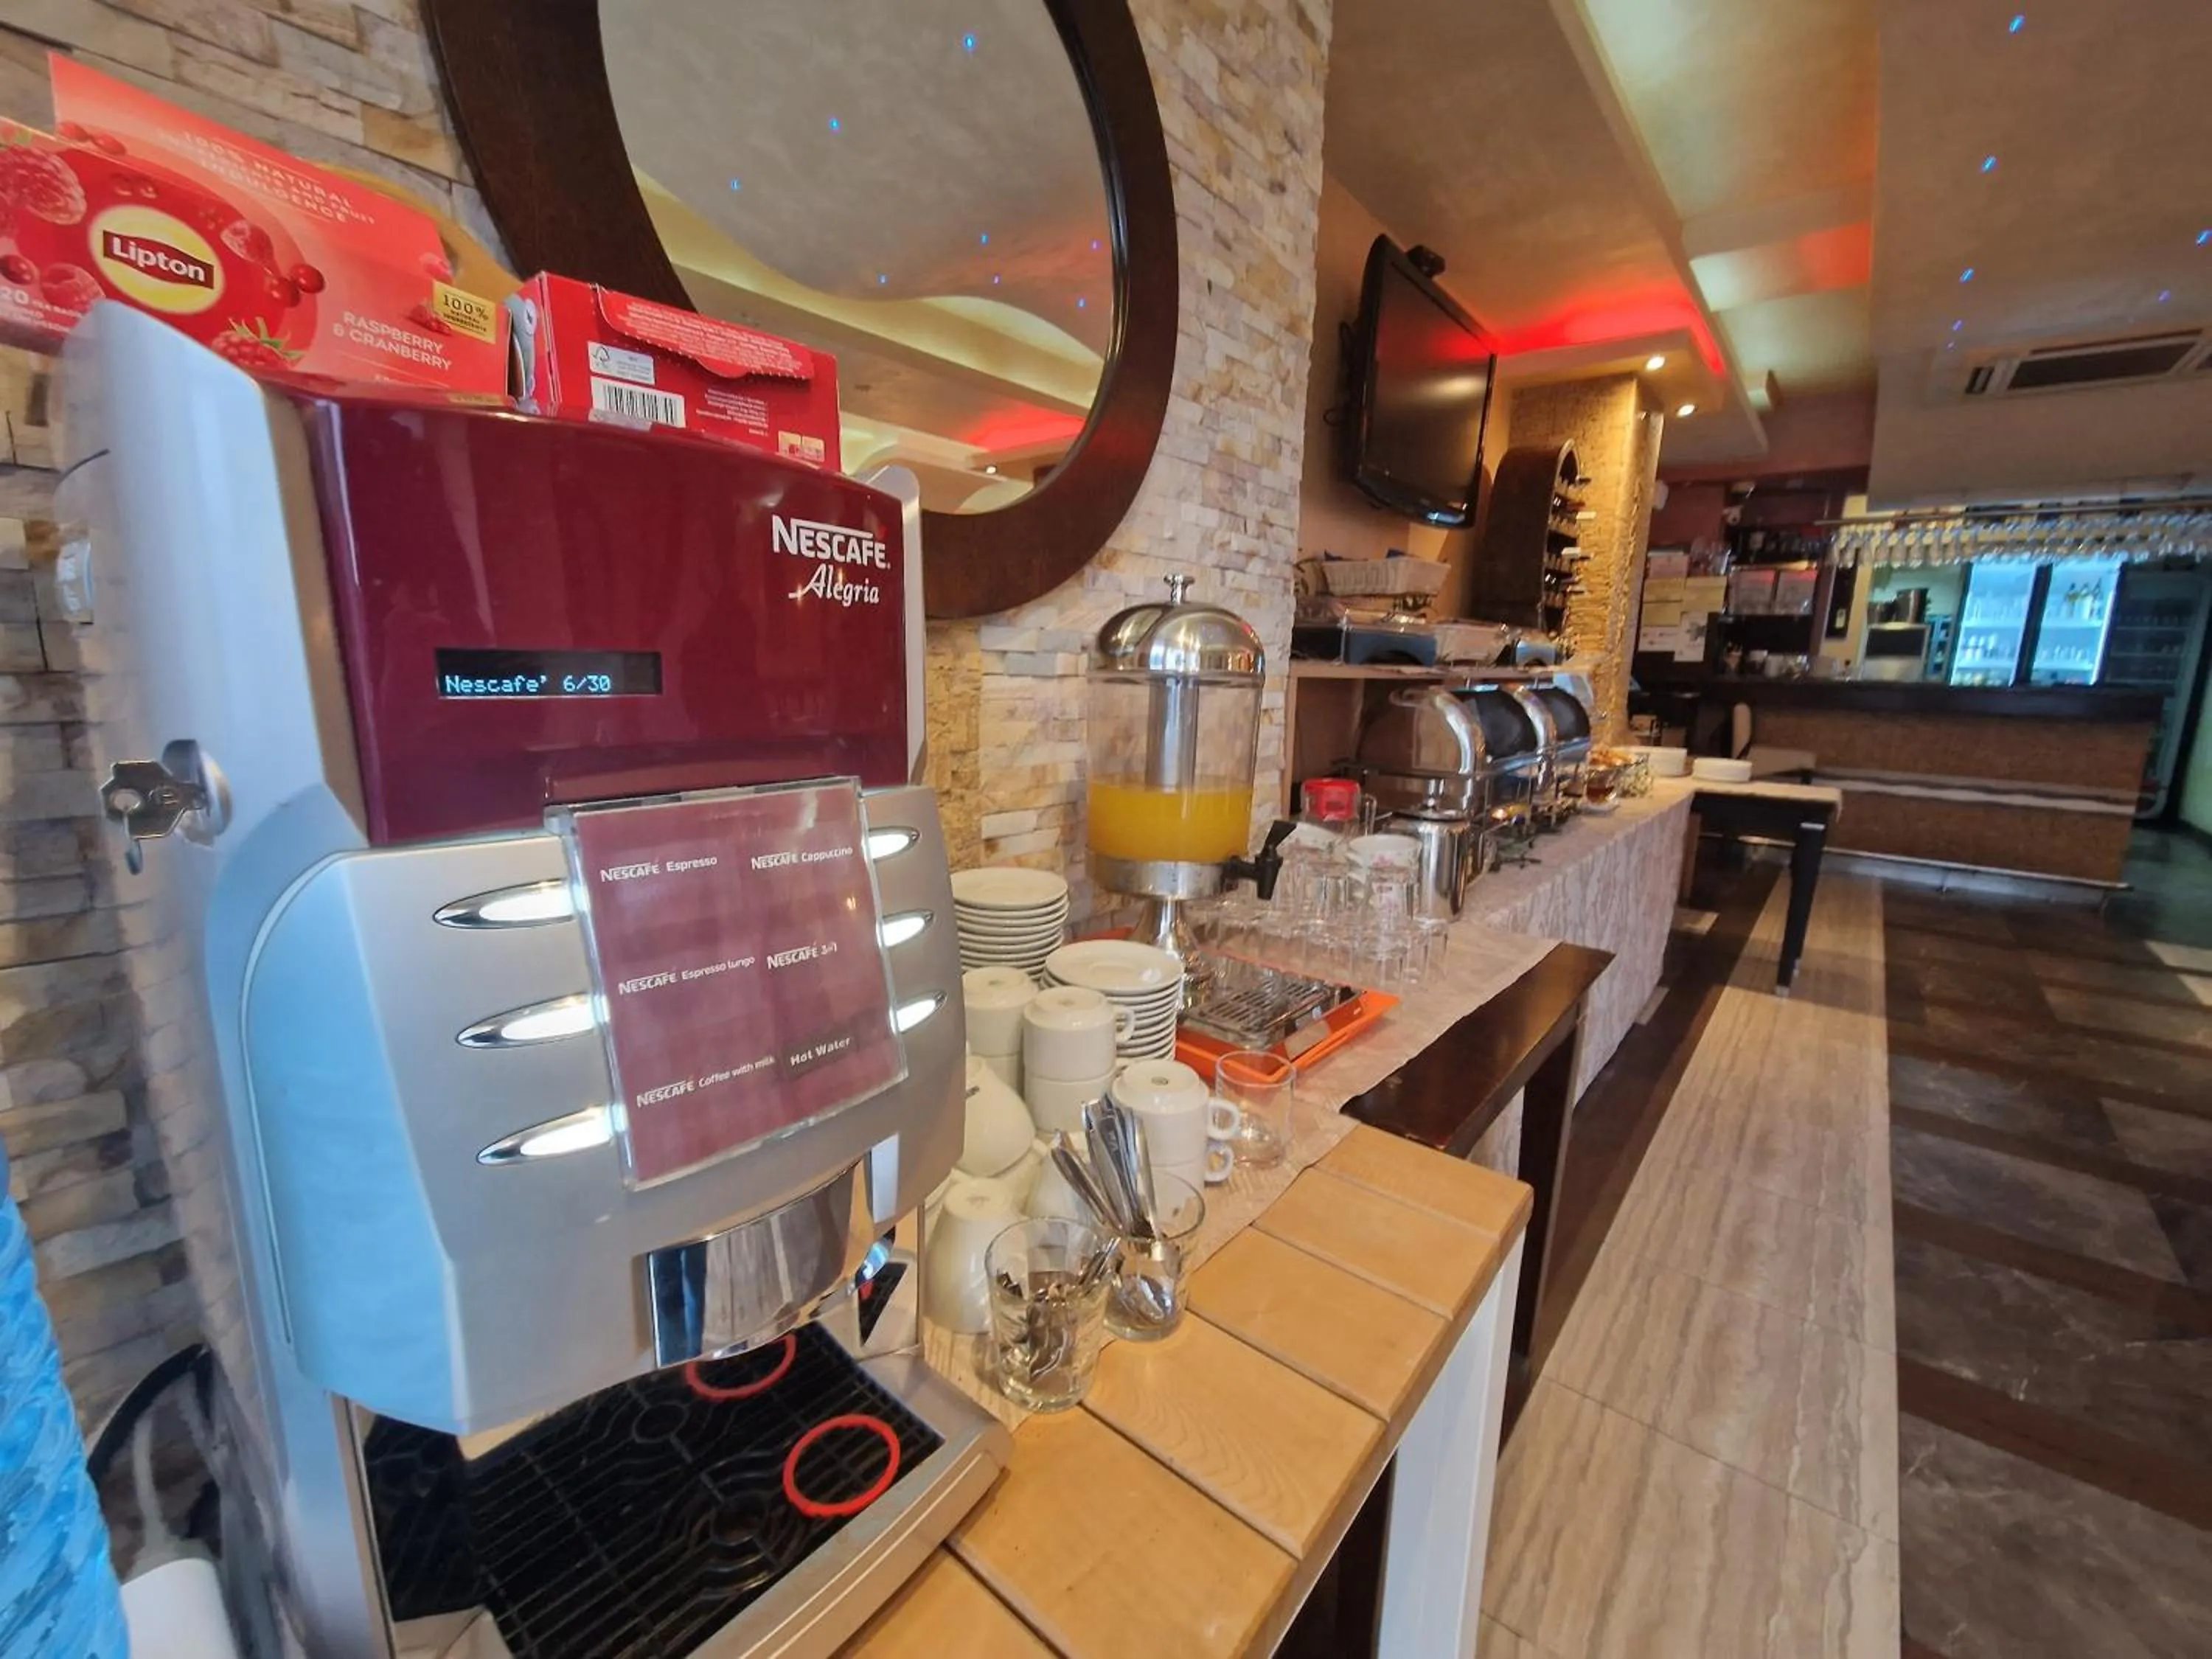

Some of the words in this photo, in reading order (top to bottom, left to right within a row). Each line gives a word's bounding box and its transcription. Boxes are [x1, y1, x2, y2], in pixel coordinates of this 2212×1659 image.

[112, 236, 206, 283] Lipton
[442, 293, 490, 321] 100%
[343, 310, 445, 355] RASPBERRY
[348, 328, 453, 370] CRANBERRY
[788, 563, 880, 608] Alegria
[563, 675, 611, 692] 6/30
[666, 855, 717, 874] Espresso
[801, 846, 853, 863] Cappuccino
[681, 961, 726, 981] Espresso
[790, 1051, 813, 1066] Hot
[815, 1036, 851, 1057] Water
[698, 1070, 731, 1088] Coffee
[731, 1062, 755, 1077] with
